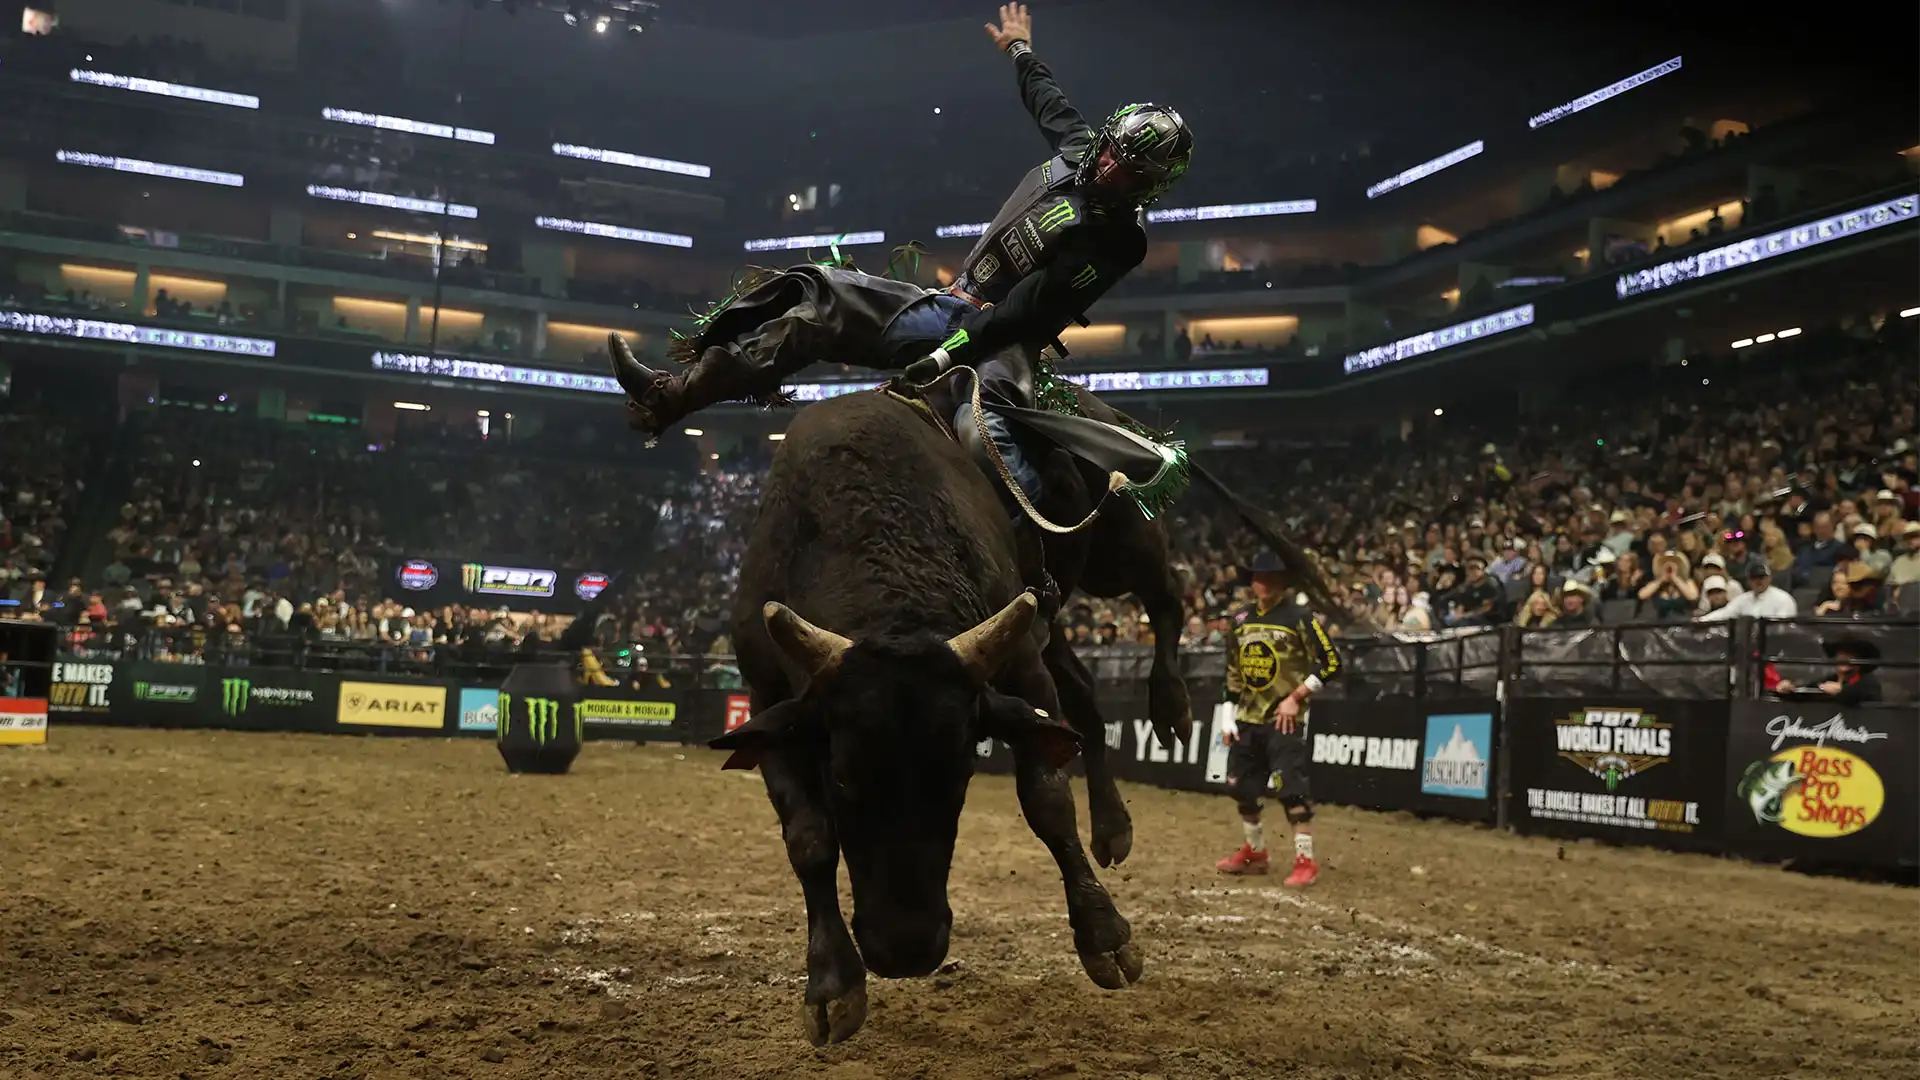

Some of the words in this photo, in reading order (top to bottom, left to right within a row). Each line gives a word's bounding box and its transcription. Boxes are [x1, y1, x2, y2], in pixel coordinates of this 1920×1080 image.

[1006, 232, 1033, 273] YETI
[64, 663, 113, 685] MAKES
[251, 687, 316, 703] MONSTER
[367, 699, 439, 714] ARIAT
[587, 704, 622, 715] MORGAN
[625, 706, 632, 716] &
[634, 706, 671, 717] MORGAN
[1584, 711, 1641, 727] PBR
[1312, 734, 1365, 766] BOOT
[1365, 737, 1419, 770] BARN
[1556, 725, 1611, 752] WORLD
[1613, 728, 1671, 756] FINALS
[1799, 750, 1853, 777] Bass
[1800, 776, 1840, 801] Pro
[1796, 797, 1867, 830] Shops
